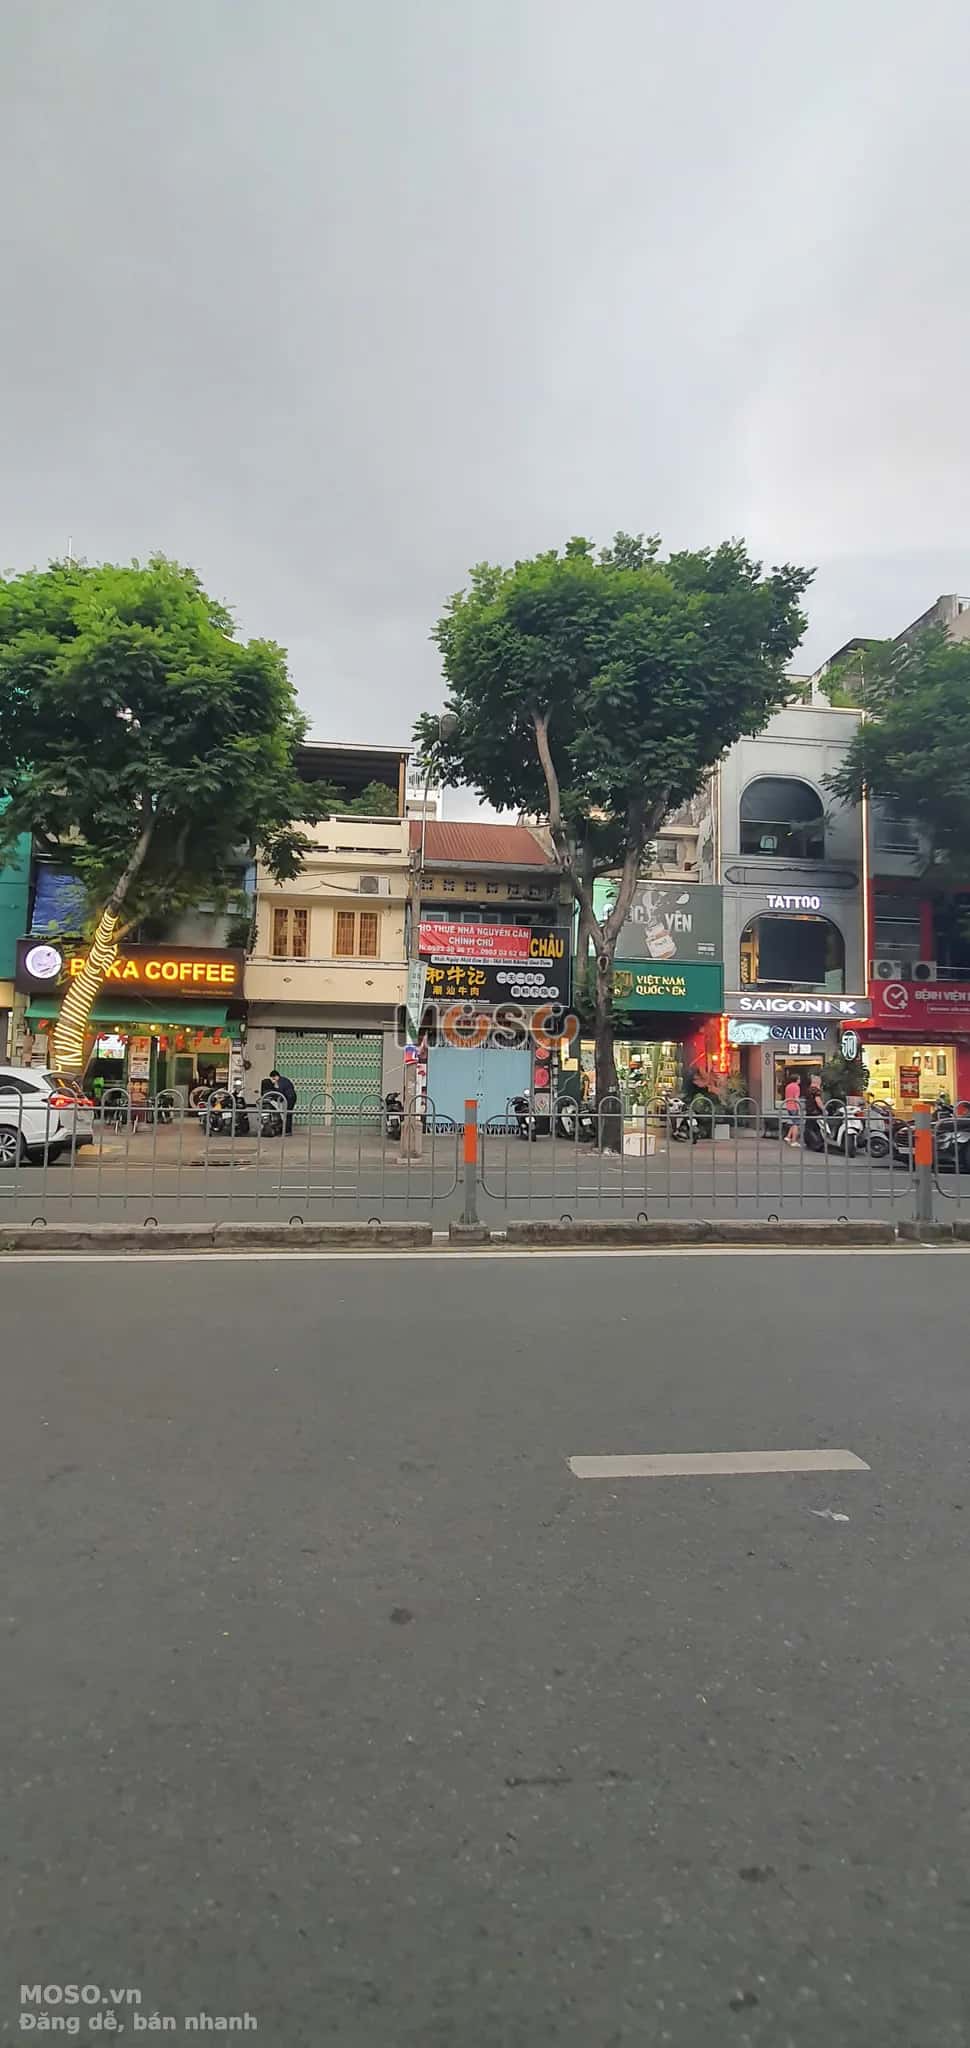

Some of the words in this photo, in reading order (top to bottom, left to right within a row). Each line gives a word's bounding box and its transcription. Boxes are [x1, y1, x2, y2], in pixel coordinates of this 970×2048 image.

[767, 895, 821, 909] TATTOO
[70, 958, 139, 978] BKA
[145, 961, 236, 983] COFFEE
[662, 976, 686, 986] NAM
[770, 1025, 828, 1041] GALLERY
